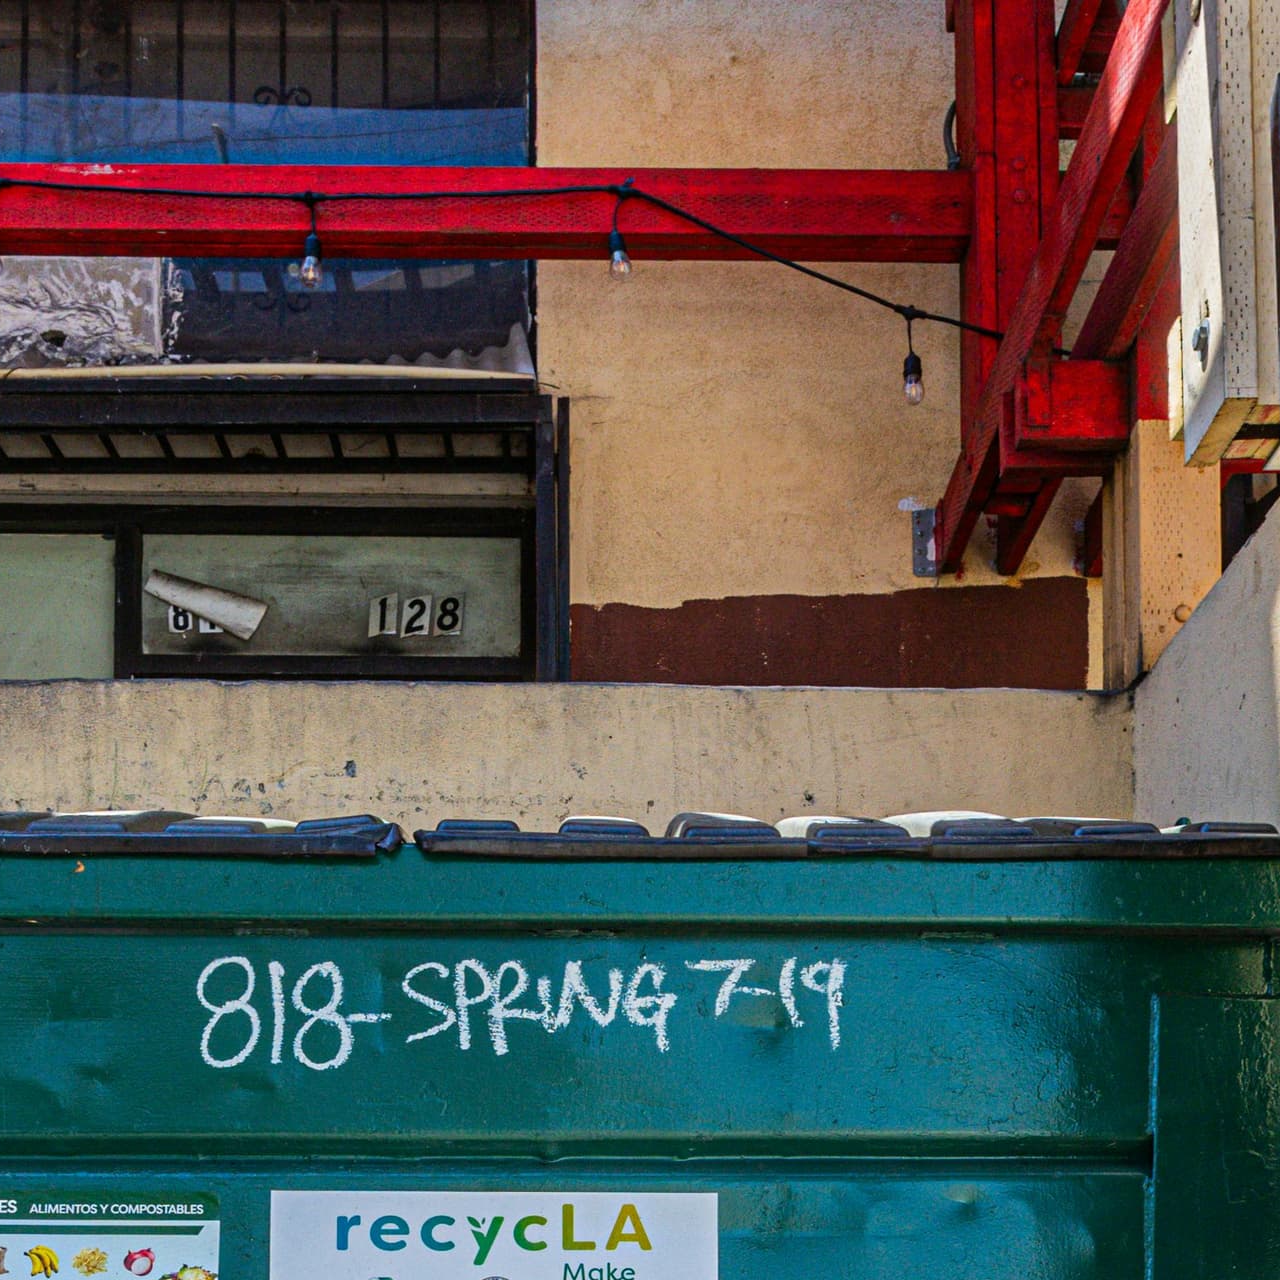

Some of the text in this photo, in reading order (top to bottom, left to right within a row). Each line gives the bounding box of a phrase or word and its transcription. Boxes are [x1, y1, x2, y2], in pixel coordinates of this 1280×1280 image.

[377, 596, 460, 634] 128
[401, 958, 676, 1054] SPRING
[684, 956, 848, 1051] 7-19
[30, 1203, 204, 1215] ALIMENTOS Y COMPOSTABLES
[336, 1203, 653, 1266] recycLA
